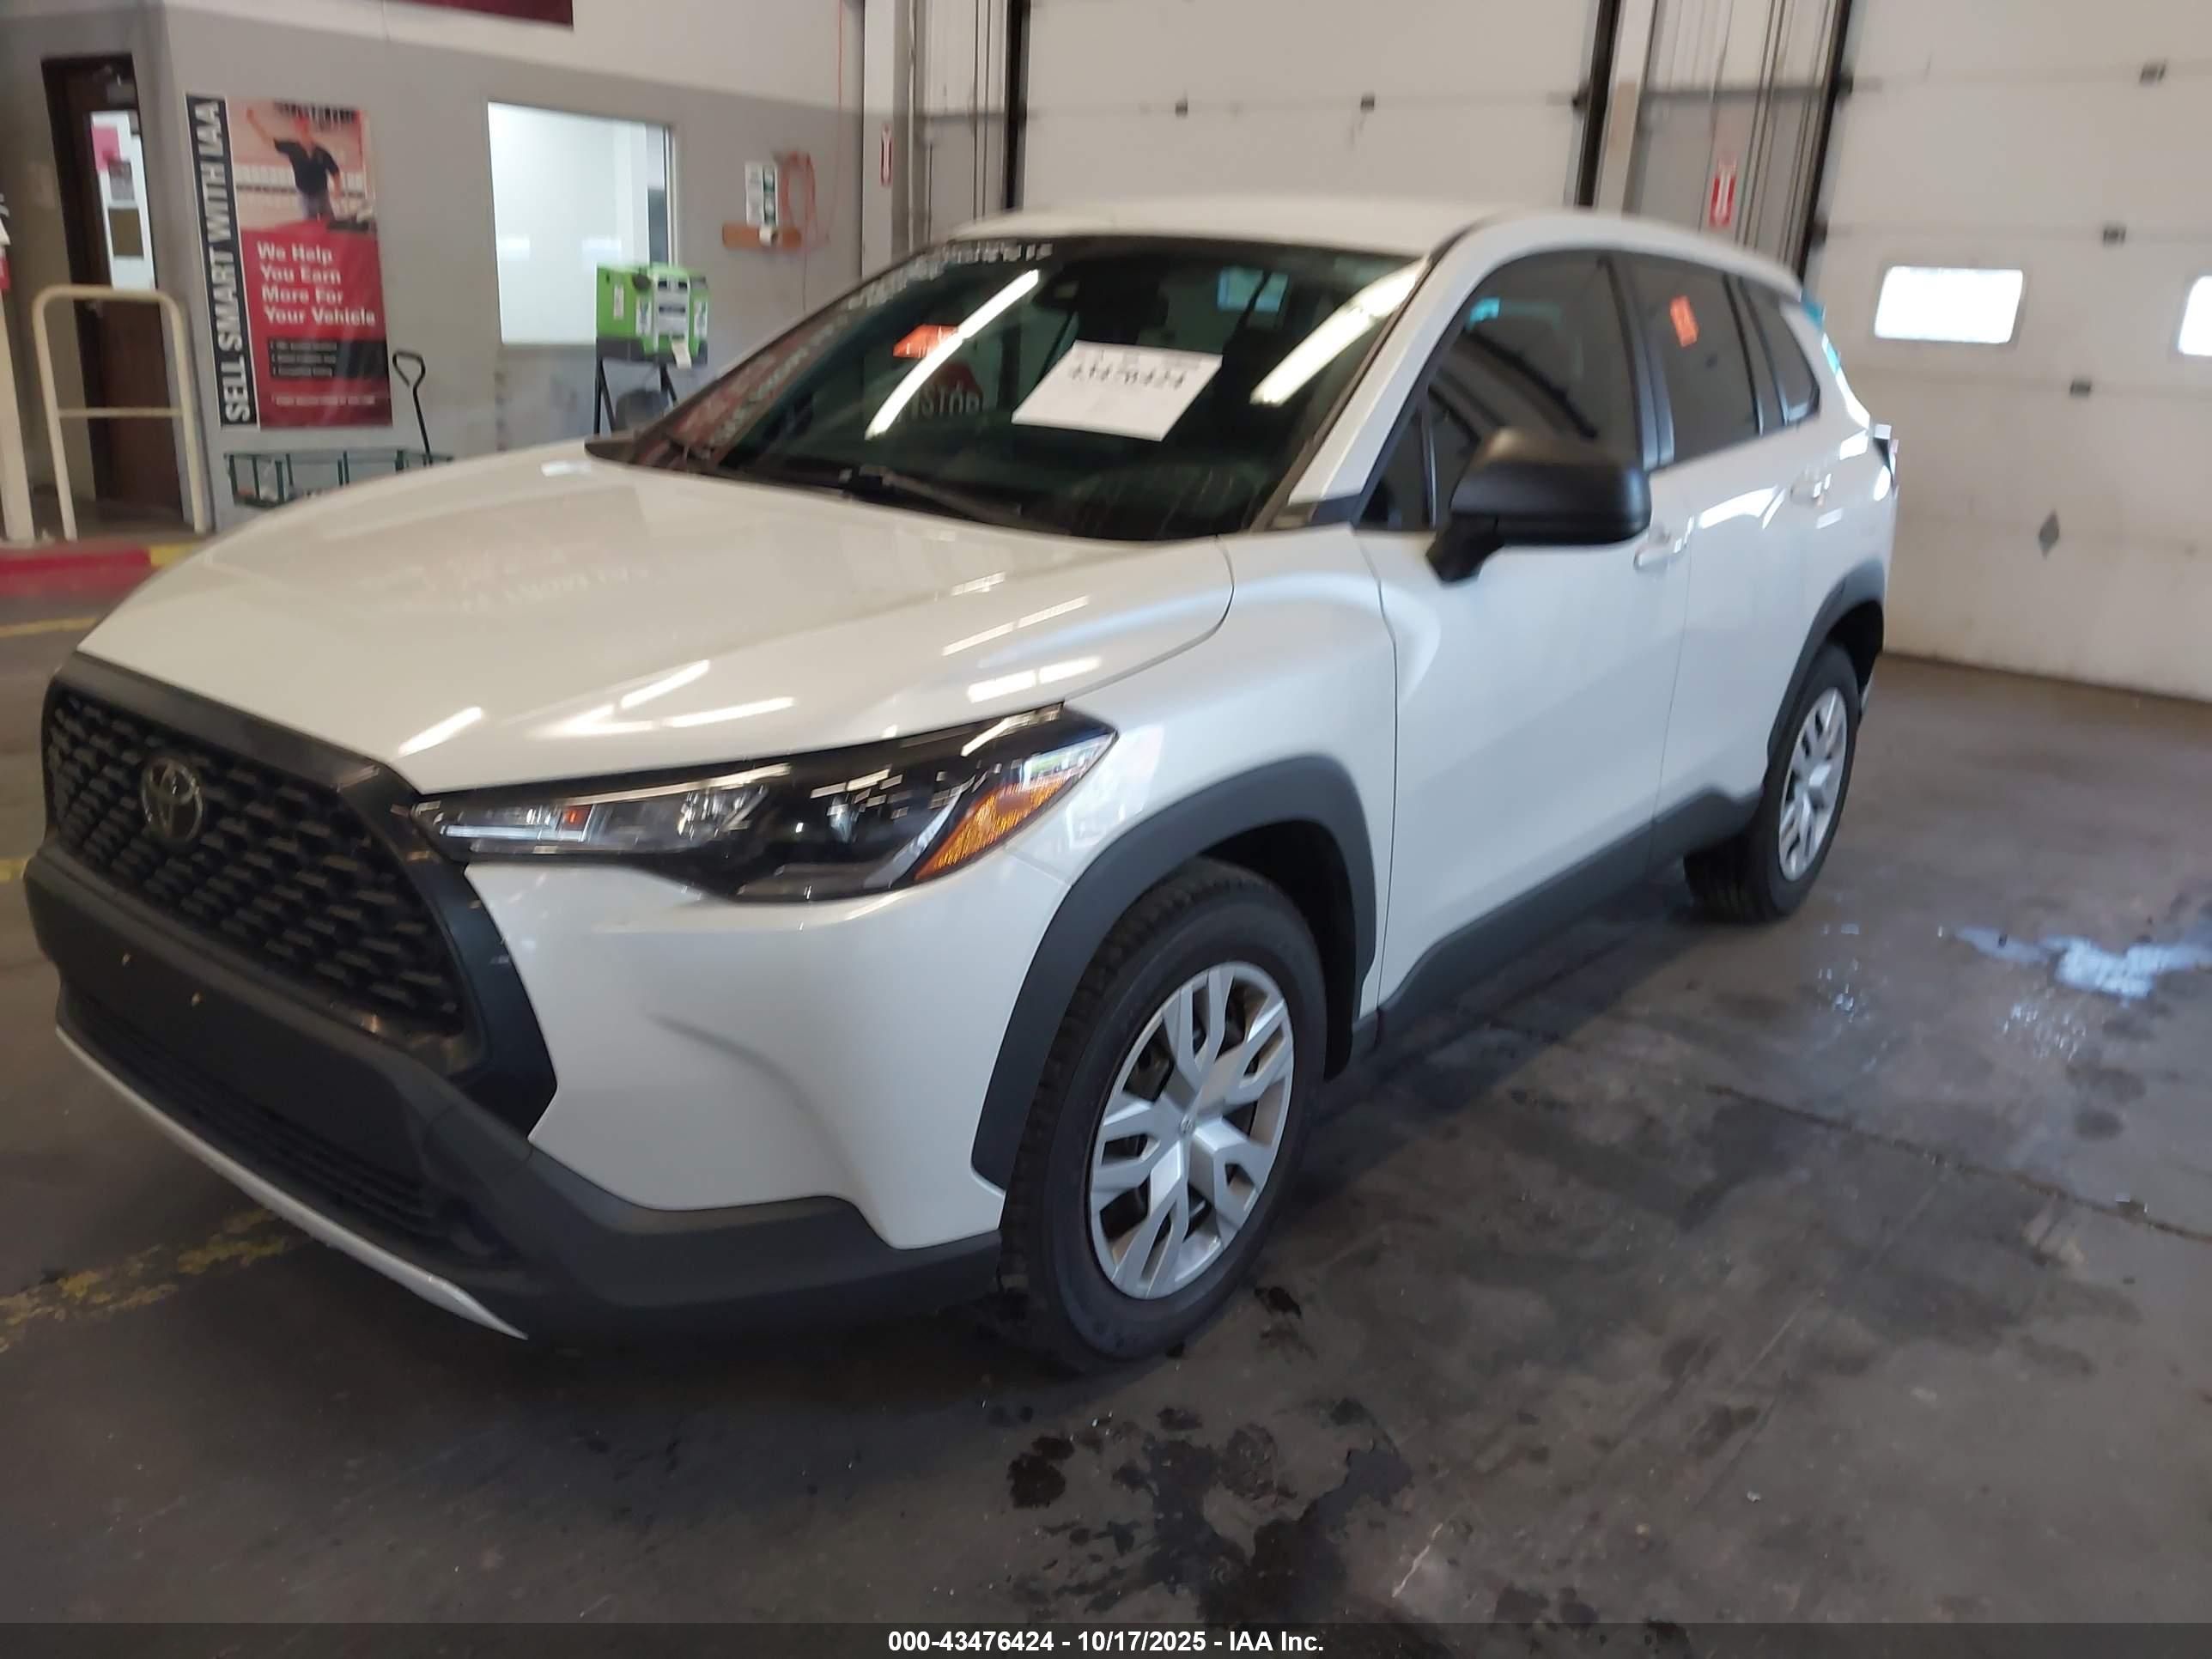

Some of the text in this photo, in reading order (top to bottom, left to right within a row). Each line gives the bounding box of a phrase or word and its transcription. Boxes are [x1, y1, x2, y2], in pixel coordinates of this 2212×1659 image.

[194, 101, 251, 422] SELL SMART WITH IAA
[257, 240, 333, 268] We Help
[260, 262, 342, 285] You Earn
[262, 284, 343, 305] More For
[264, 305, 376, 327] Your Vehicle
